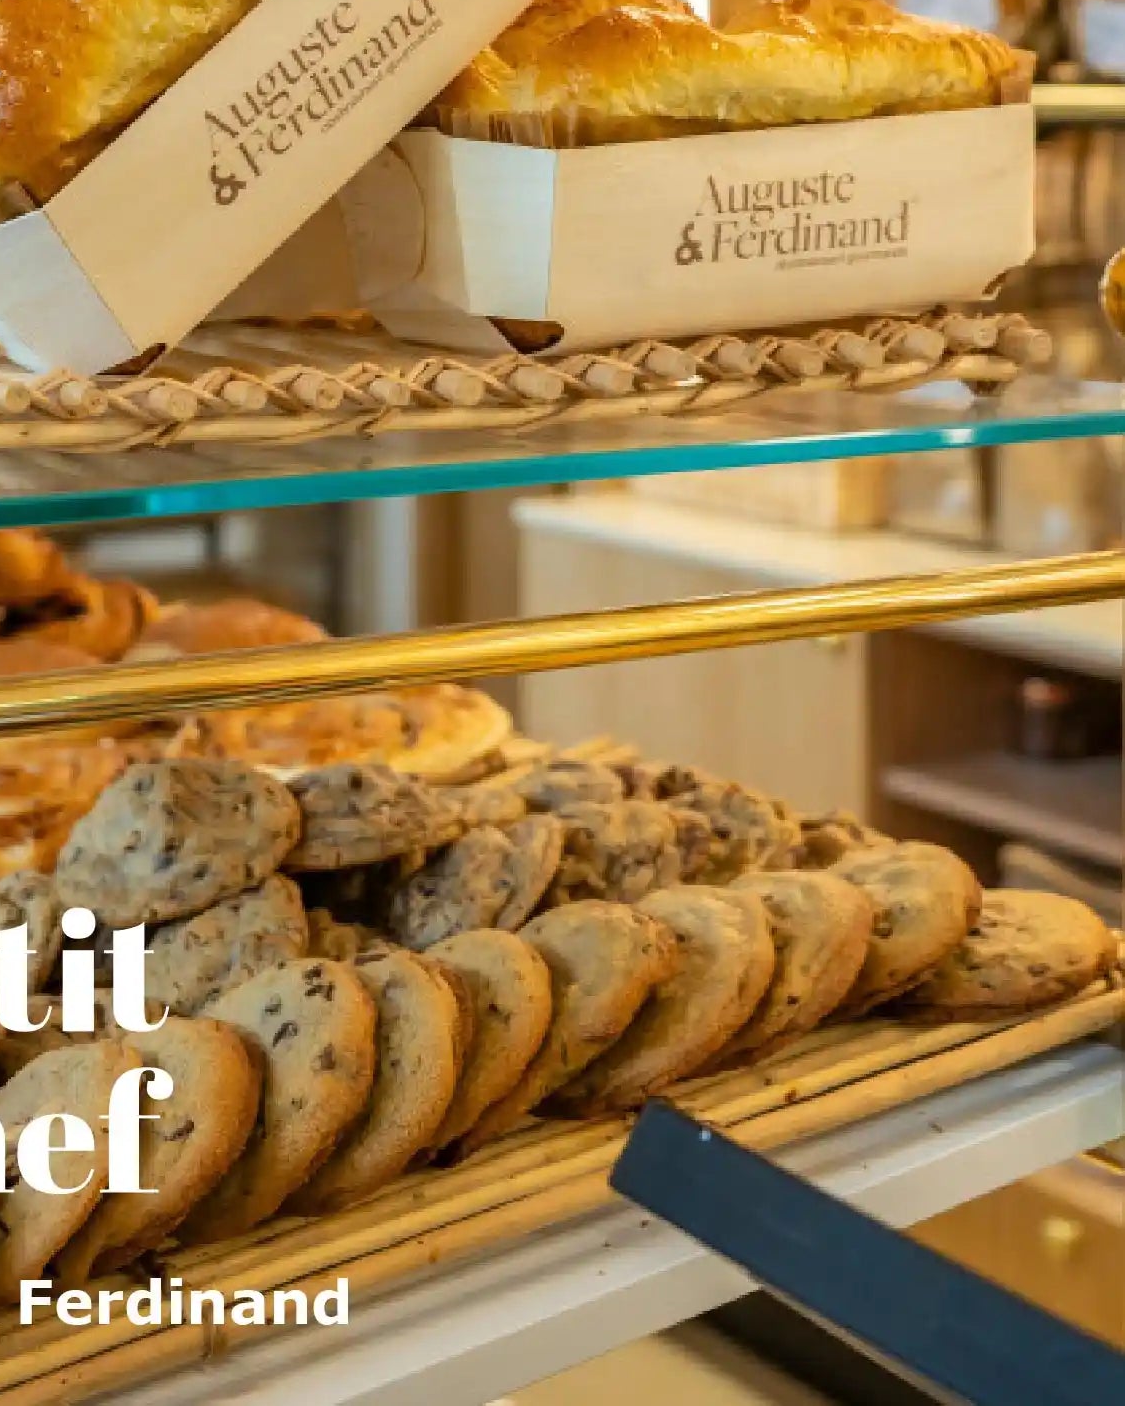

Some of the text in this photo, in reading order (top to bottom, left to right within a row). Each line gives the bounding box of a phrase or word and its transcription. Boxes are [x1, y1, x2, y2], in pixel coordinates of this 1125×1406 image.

[204, 1, 360, 157] Auguste
[695, 171, 856, 226] Auguste
[711, 199, 910, 263] Ferdinand
